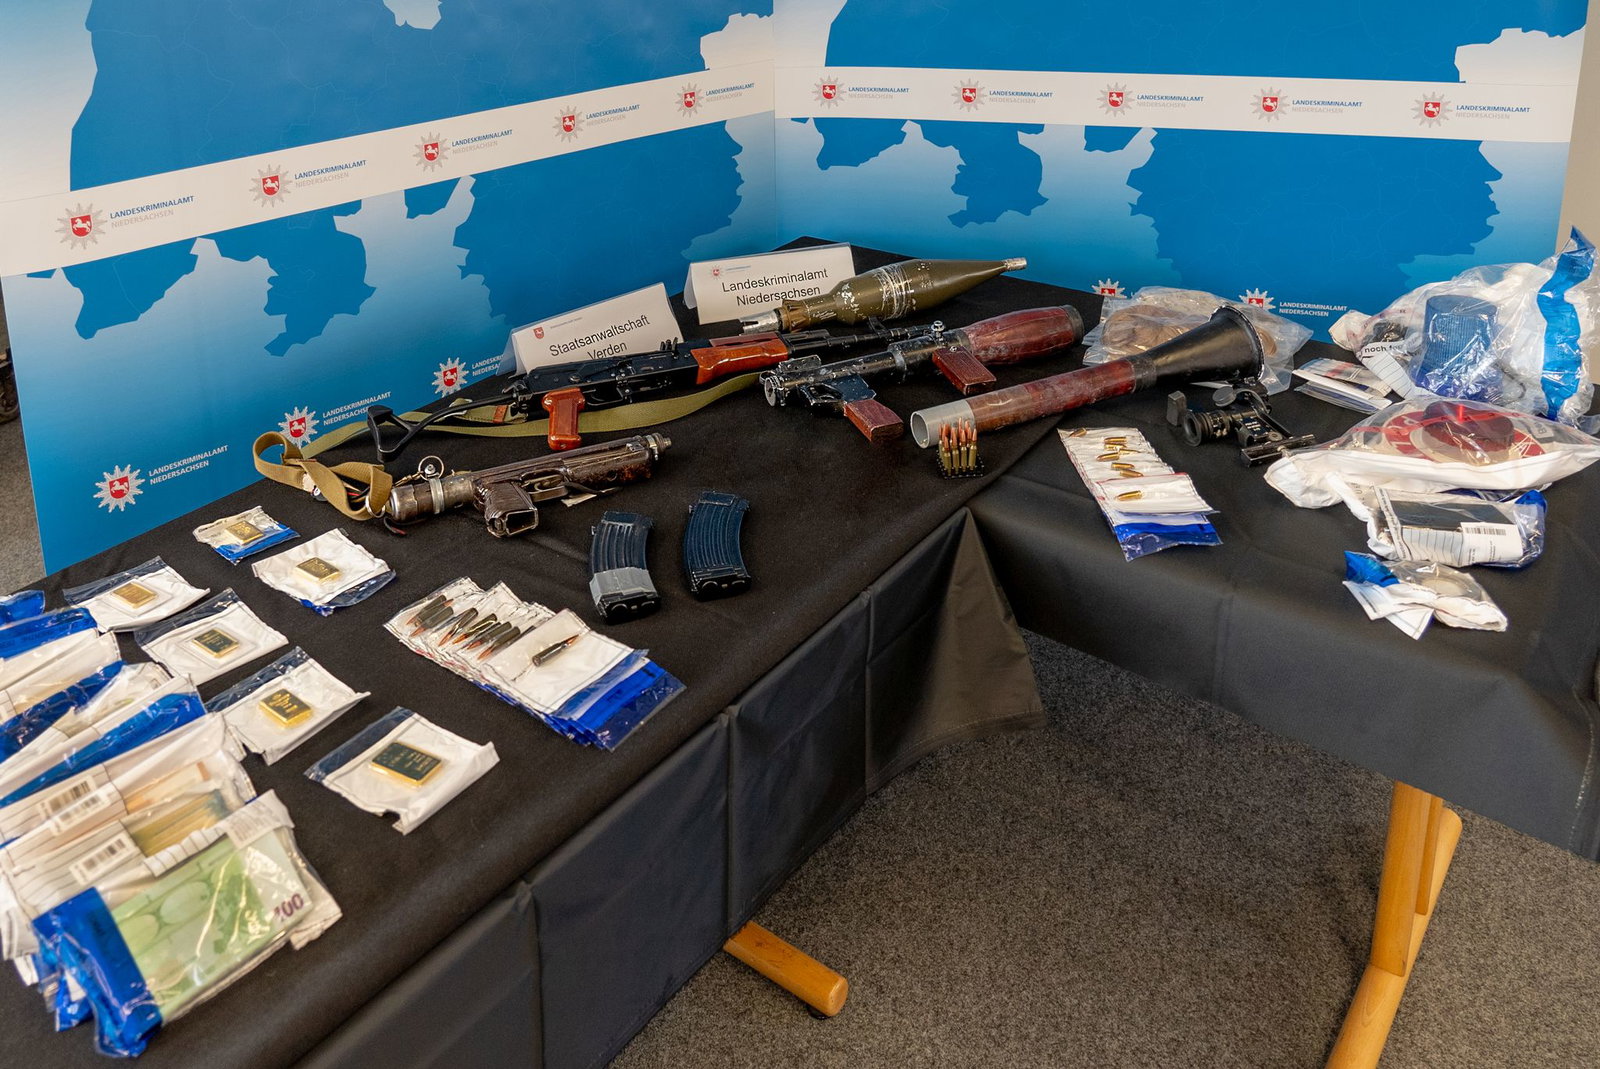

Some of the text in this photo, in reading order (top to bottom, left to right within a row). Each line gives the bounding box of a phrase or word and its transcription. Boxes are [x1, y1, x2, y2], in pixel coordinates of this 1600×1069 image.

[705, 82, 755, 96] LANDESKRIMINALAMT
[848, 86, 909, 94] LANDESKRIMINALAMT
[989, 90, 1053, 98] LANDESKRIMINALAMT
[1137, 94, 1204, 102] LANDESKRIMINALAMT
[586, 104, 640, 120] LANDESKRIMINALAMT
[1292, 99, 1363, 108] LANDESKRIMINALAMT
[1456, 104, 1531, 113] LANDESKRIMINALAMT
[451, 129, 513, 148] LANDESKRIMINALAMT
[294, 159, 367, 180] LANDESKRIMINALAMT
[295, 171, 350, 188] NIEDERSACHSEN
[109, 195, 195, 220] LANDESKRIMINALAMT
[111, 209, 174, 229] NIEDERSACHSEN
[722, 268, 829, 293] Landeskriminalamt
[736, 286, 821, 306] Niedersachsen
[1279, 308, 1329, 317] NIEDERSACHSEN
[1280, 301, 1348, 312] LANDESKRIMINALAMT
[549, 314, 651, 357] Staatsanwaltschaft
[587, 341, 628, 361] Verden
[322, 391, 392, 418] LANDESKRIMINALAMT
[323, 406, 369, 426] NIEDERSACHSE
[148, 444, 229, 477] LANDESKRIMINALAMT
[149, 460, 209, 485] NIEDERSACHSEN
